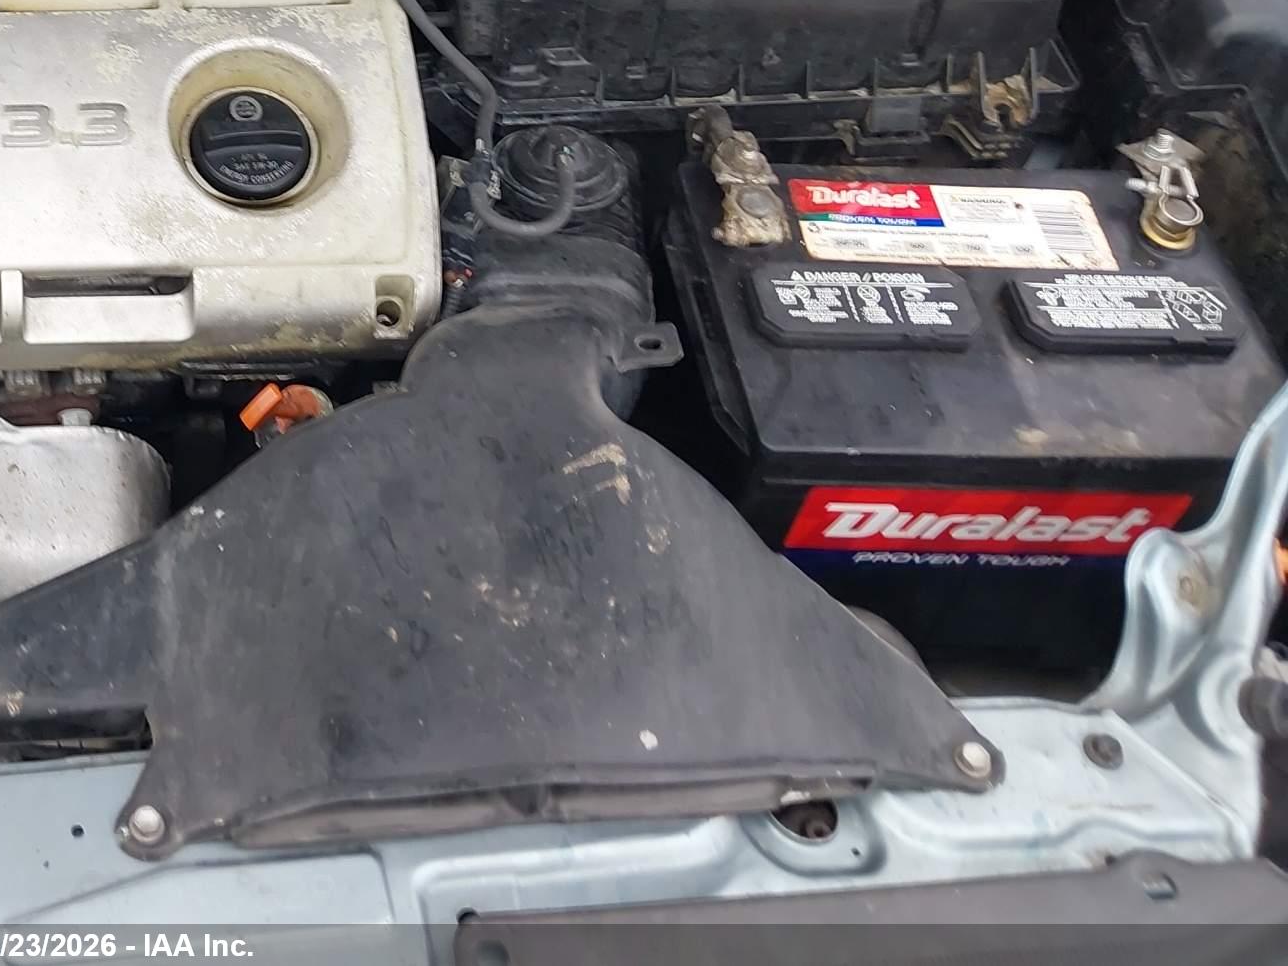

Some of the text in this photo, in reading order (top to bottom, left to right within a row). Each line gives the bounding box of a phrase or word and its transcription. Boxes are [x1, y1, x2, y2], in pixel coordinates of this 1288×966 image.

[1, 102, 135, 148] 3.3
[806, 186, 920, 209] Duralast
[804, 271, 861, 283] DANGER
[872, 272, 925, 283] POISON
[822, 502, 1152, 543] Duralast
[852, 551, 1071, 566] PROVEN TOUGH
